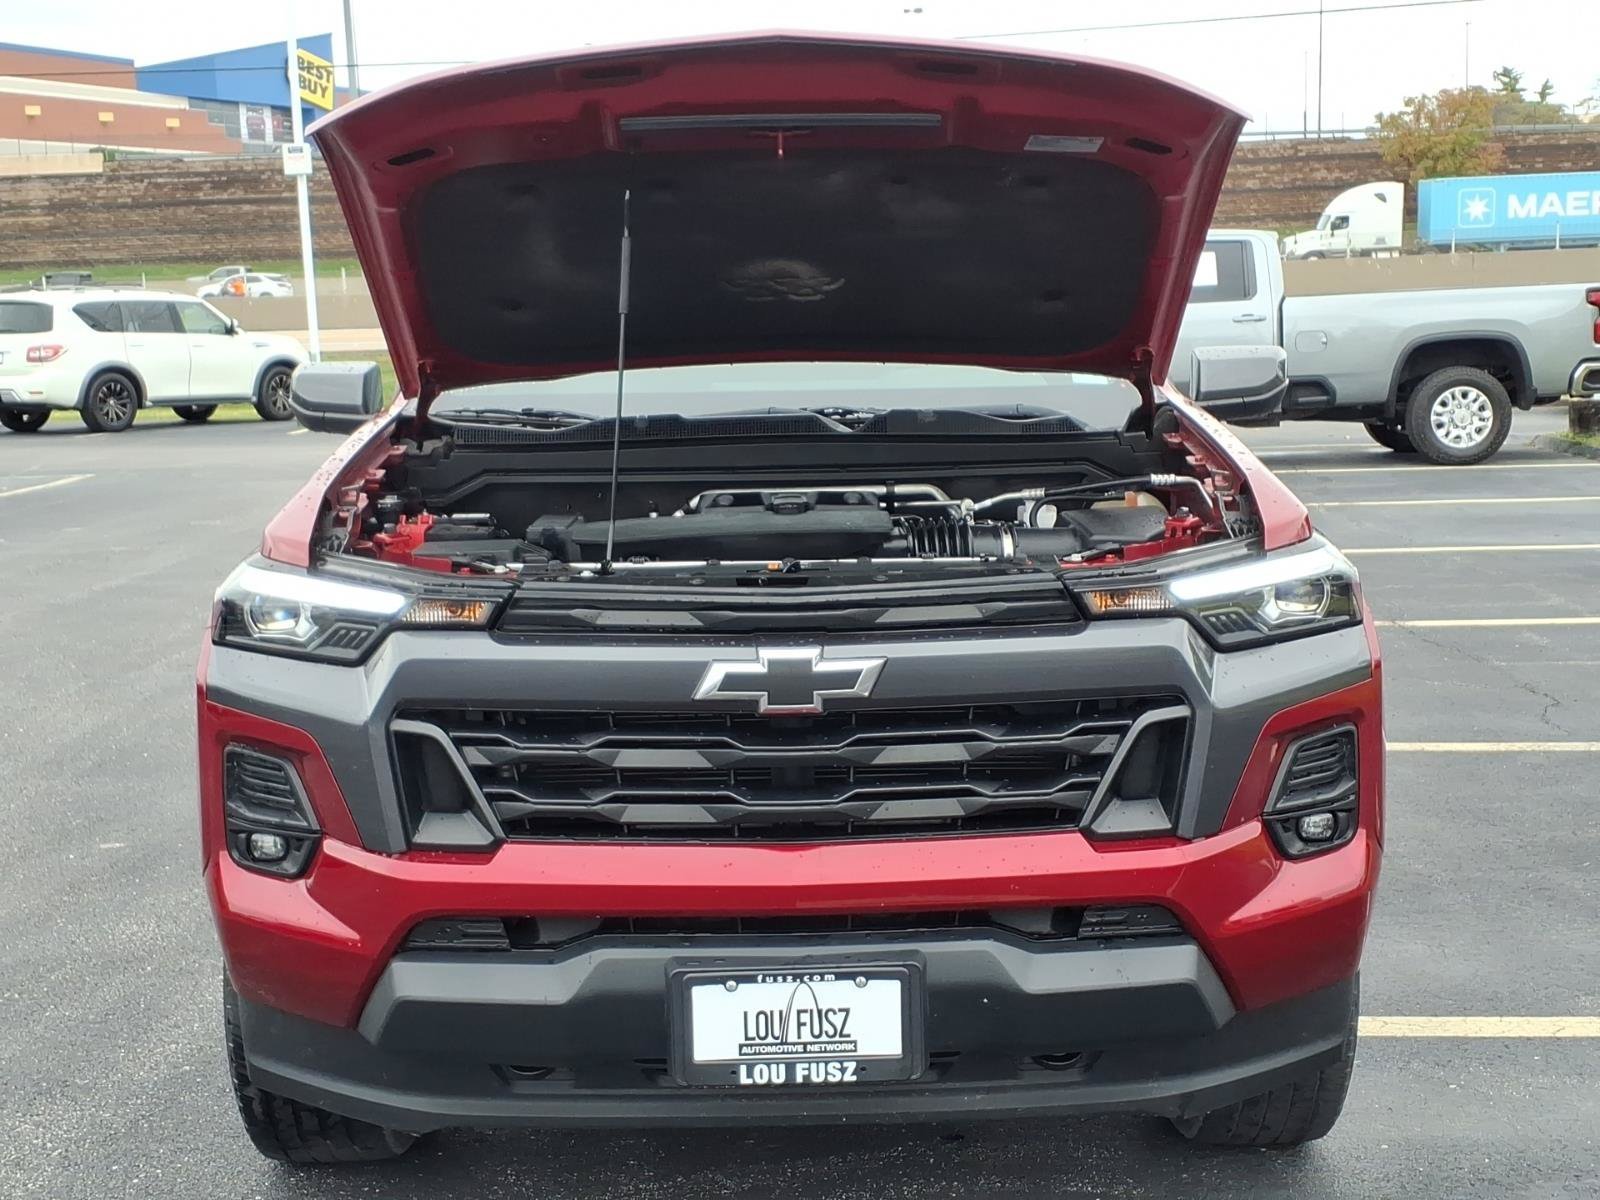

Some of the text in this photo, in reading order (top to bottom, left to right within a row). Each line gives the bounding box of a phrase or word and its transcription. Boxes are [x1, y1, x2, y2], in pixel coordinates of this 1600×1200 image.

[297, 54, 333, 83] BEST
[298, 72, 328, 98] BUY
[756, 973, 836, 983] fusz.com
[743, 1008, 851, 1041] LOU FUSZ
[741, 1042, 855, 1054] AUTOMOTIVE NETWORK
[739, 1061, 857, 1084] LOU FUSZ
